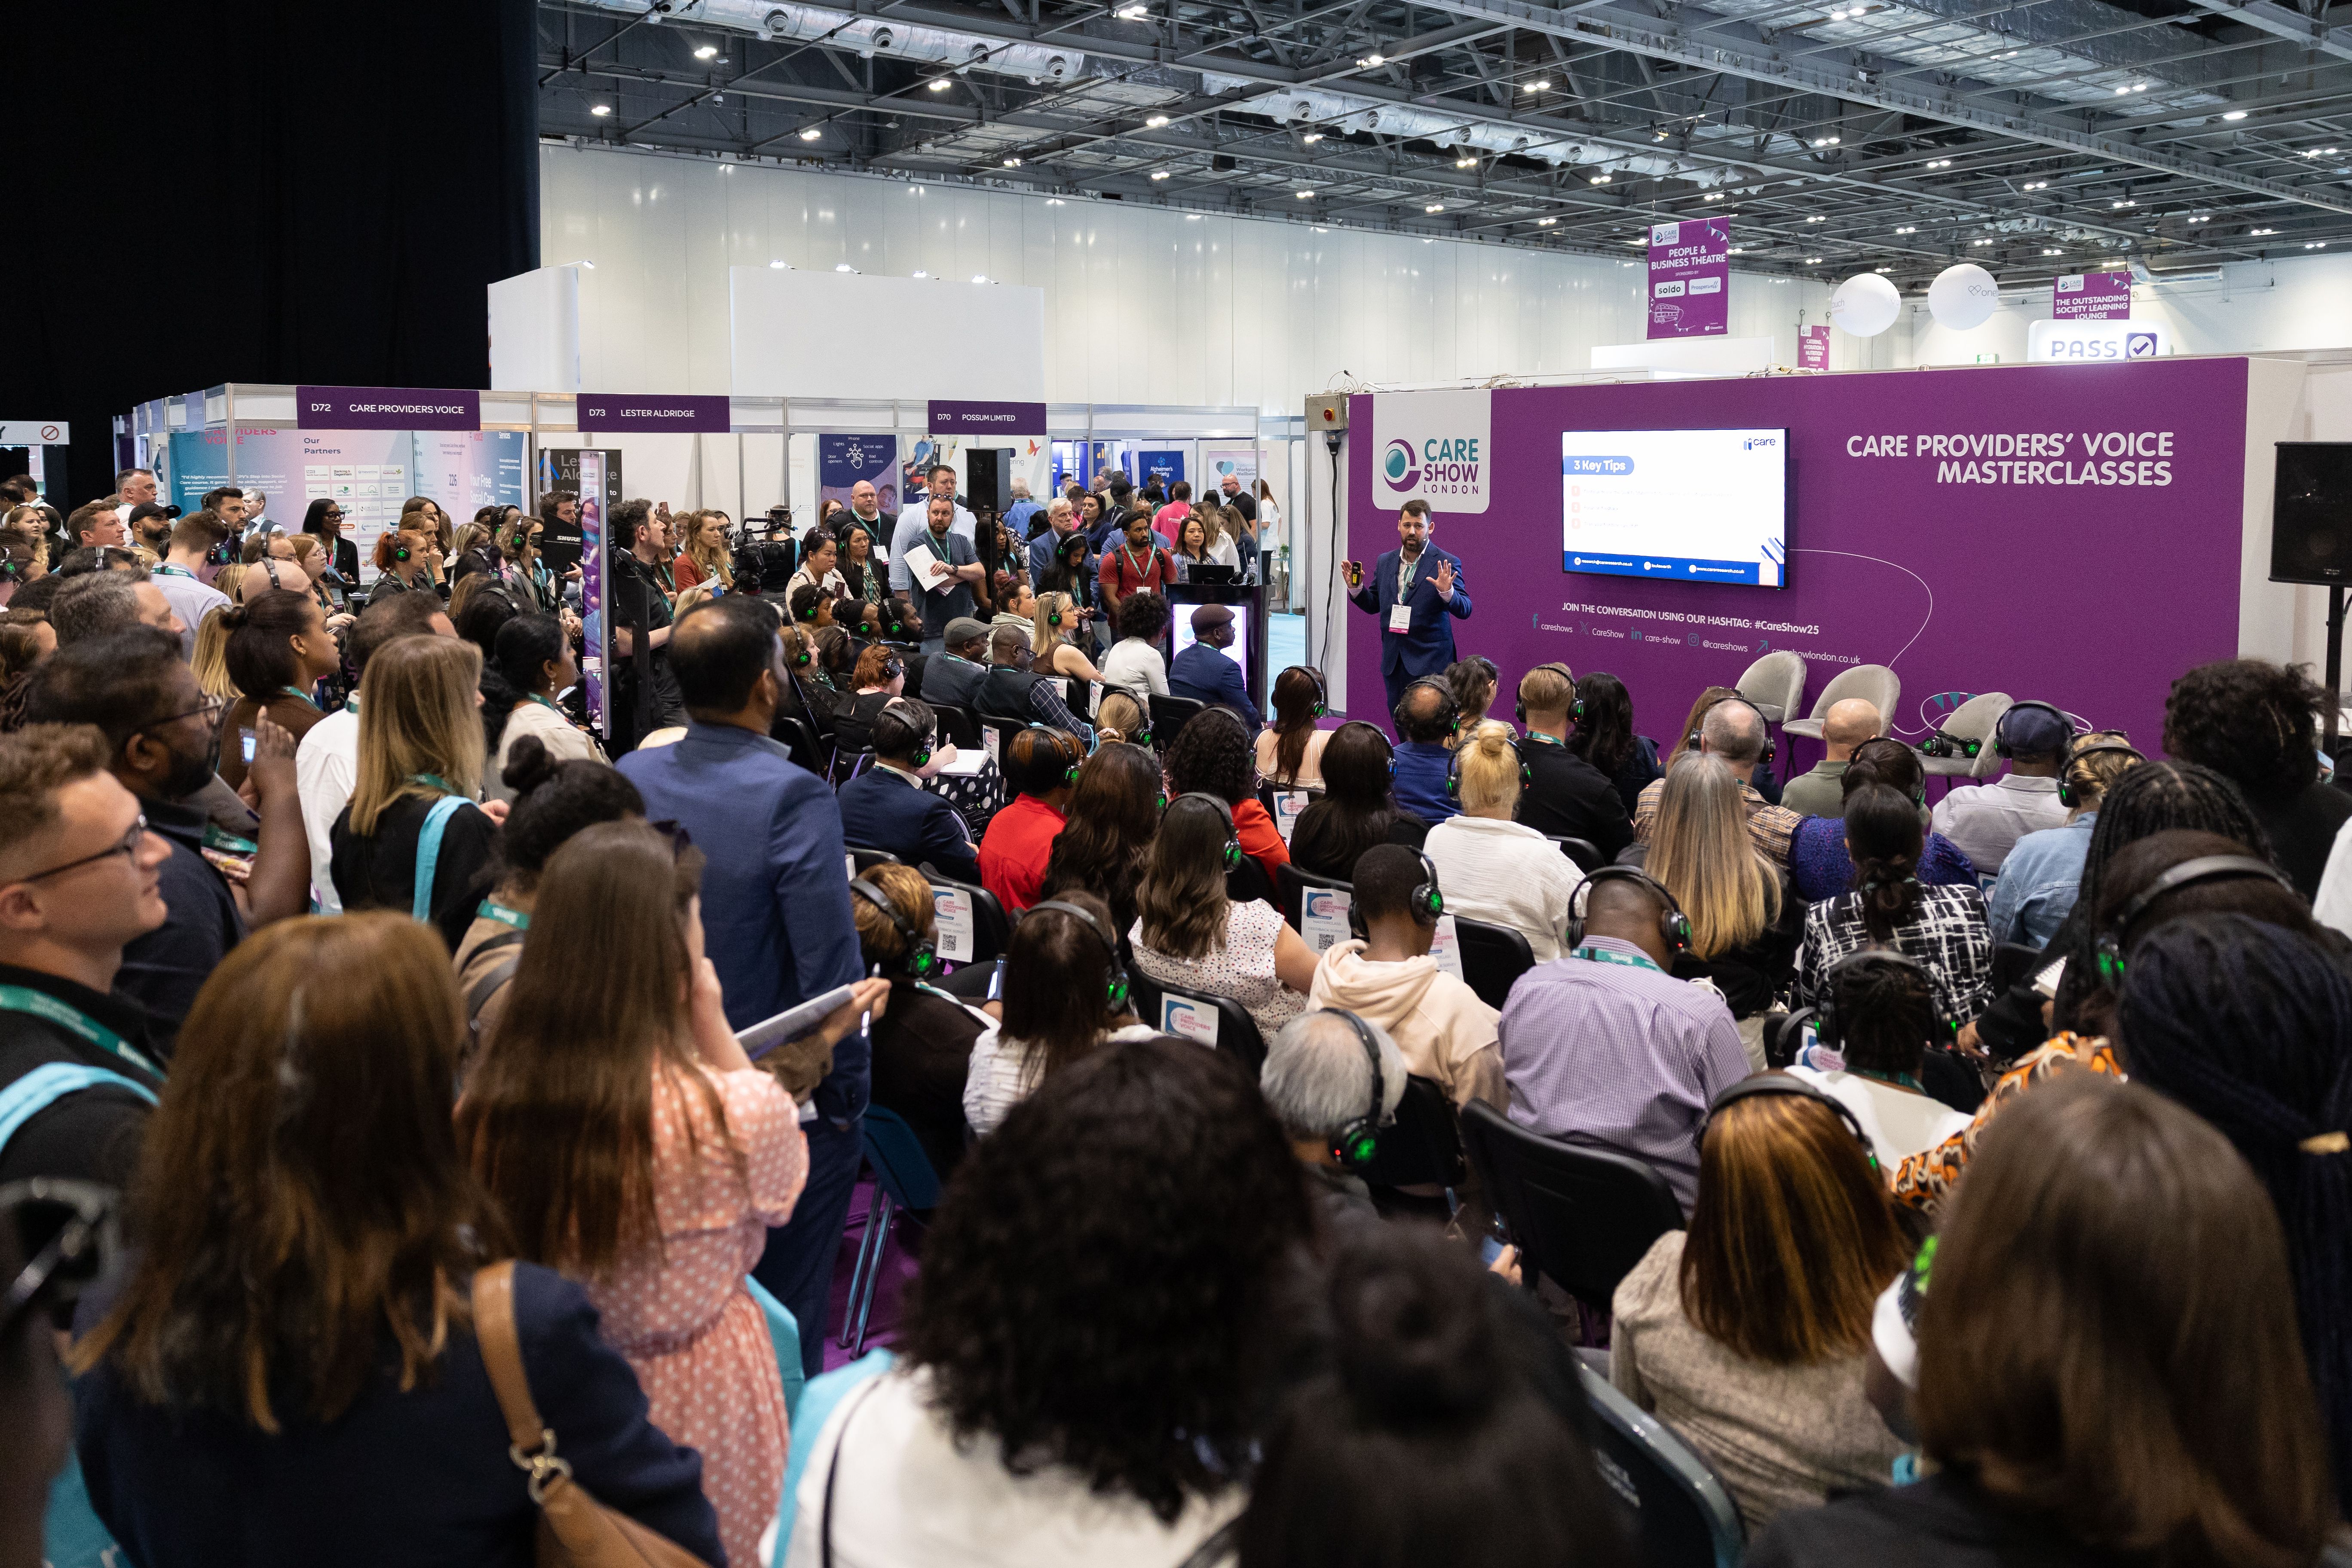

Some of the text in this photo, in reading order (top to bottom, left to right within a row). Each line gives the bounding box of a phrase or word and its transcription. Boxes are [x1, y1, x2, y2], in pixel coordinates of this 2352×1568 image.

[1669, 245, 1706, 258] PEOPLE &
[1651, 254, 1726, 270] BUSINESS THEATRE
[1659, 285, 1681, 294] soldo
[2074, 294, 2128, 305] OUTSTANDING
[2056, 303, 2128, 314] SOCIETY LEARNING
[2052, 340, 2117, 357] PASS
[349, 404, 377, 412] CARE
[378, 405, 433, 413] PROVIDERS
[206, 436, 245, 444] VOIE
[1847, 435, 1908, 456] CARE
[2082, 432, 2174, 456] VOICE
[1424, 438, 1478, 462] CARE
[1424, 463, 1479, 482] SHOW
[1574, 459, 1626, 473] 3 Key Tips
[1937, 461, 2173, 486] MASTERCLASSES
[470, 474, 491, 488] Your Free
[1424, 484, 1478, 494] LONDON
[470, 490, 483, 504] Social
[484, 492, 495, 506] Care
[1562, 603, 1819, 634] JOIN THE CONVERSATION USING OUR HASHTAG: #CareShow25
[1541, 623, 1573, 633] careshows
[1592, 628, 1624, 638] CareShow
[1645, 635, 1681, 645] care-show
[1703, 640, 1748, 652] @careshows
